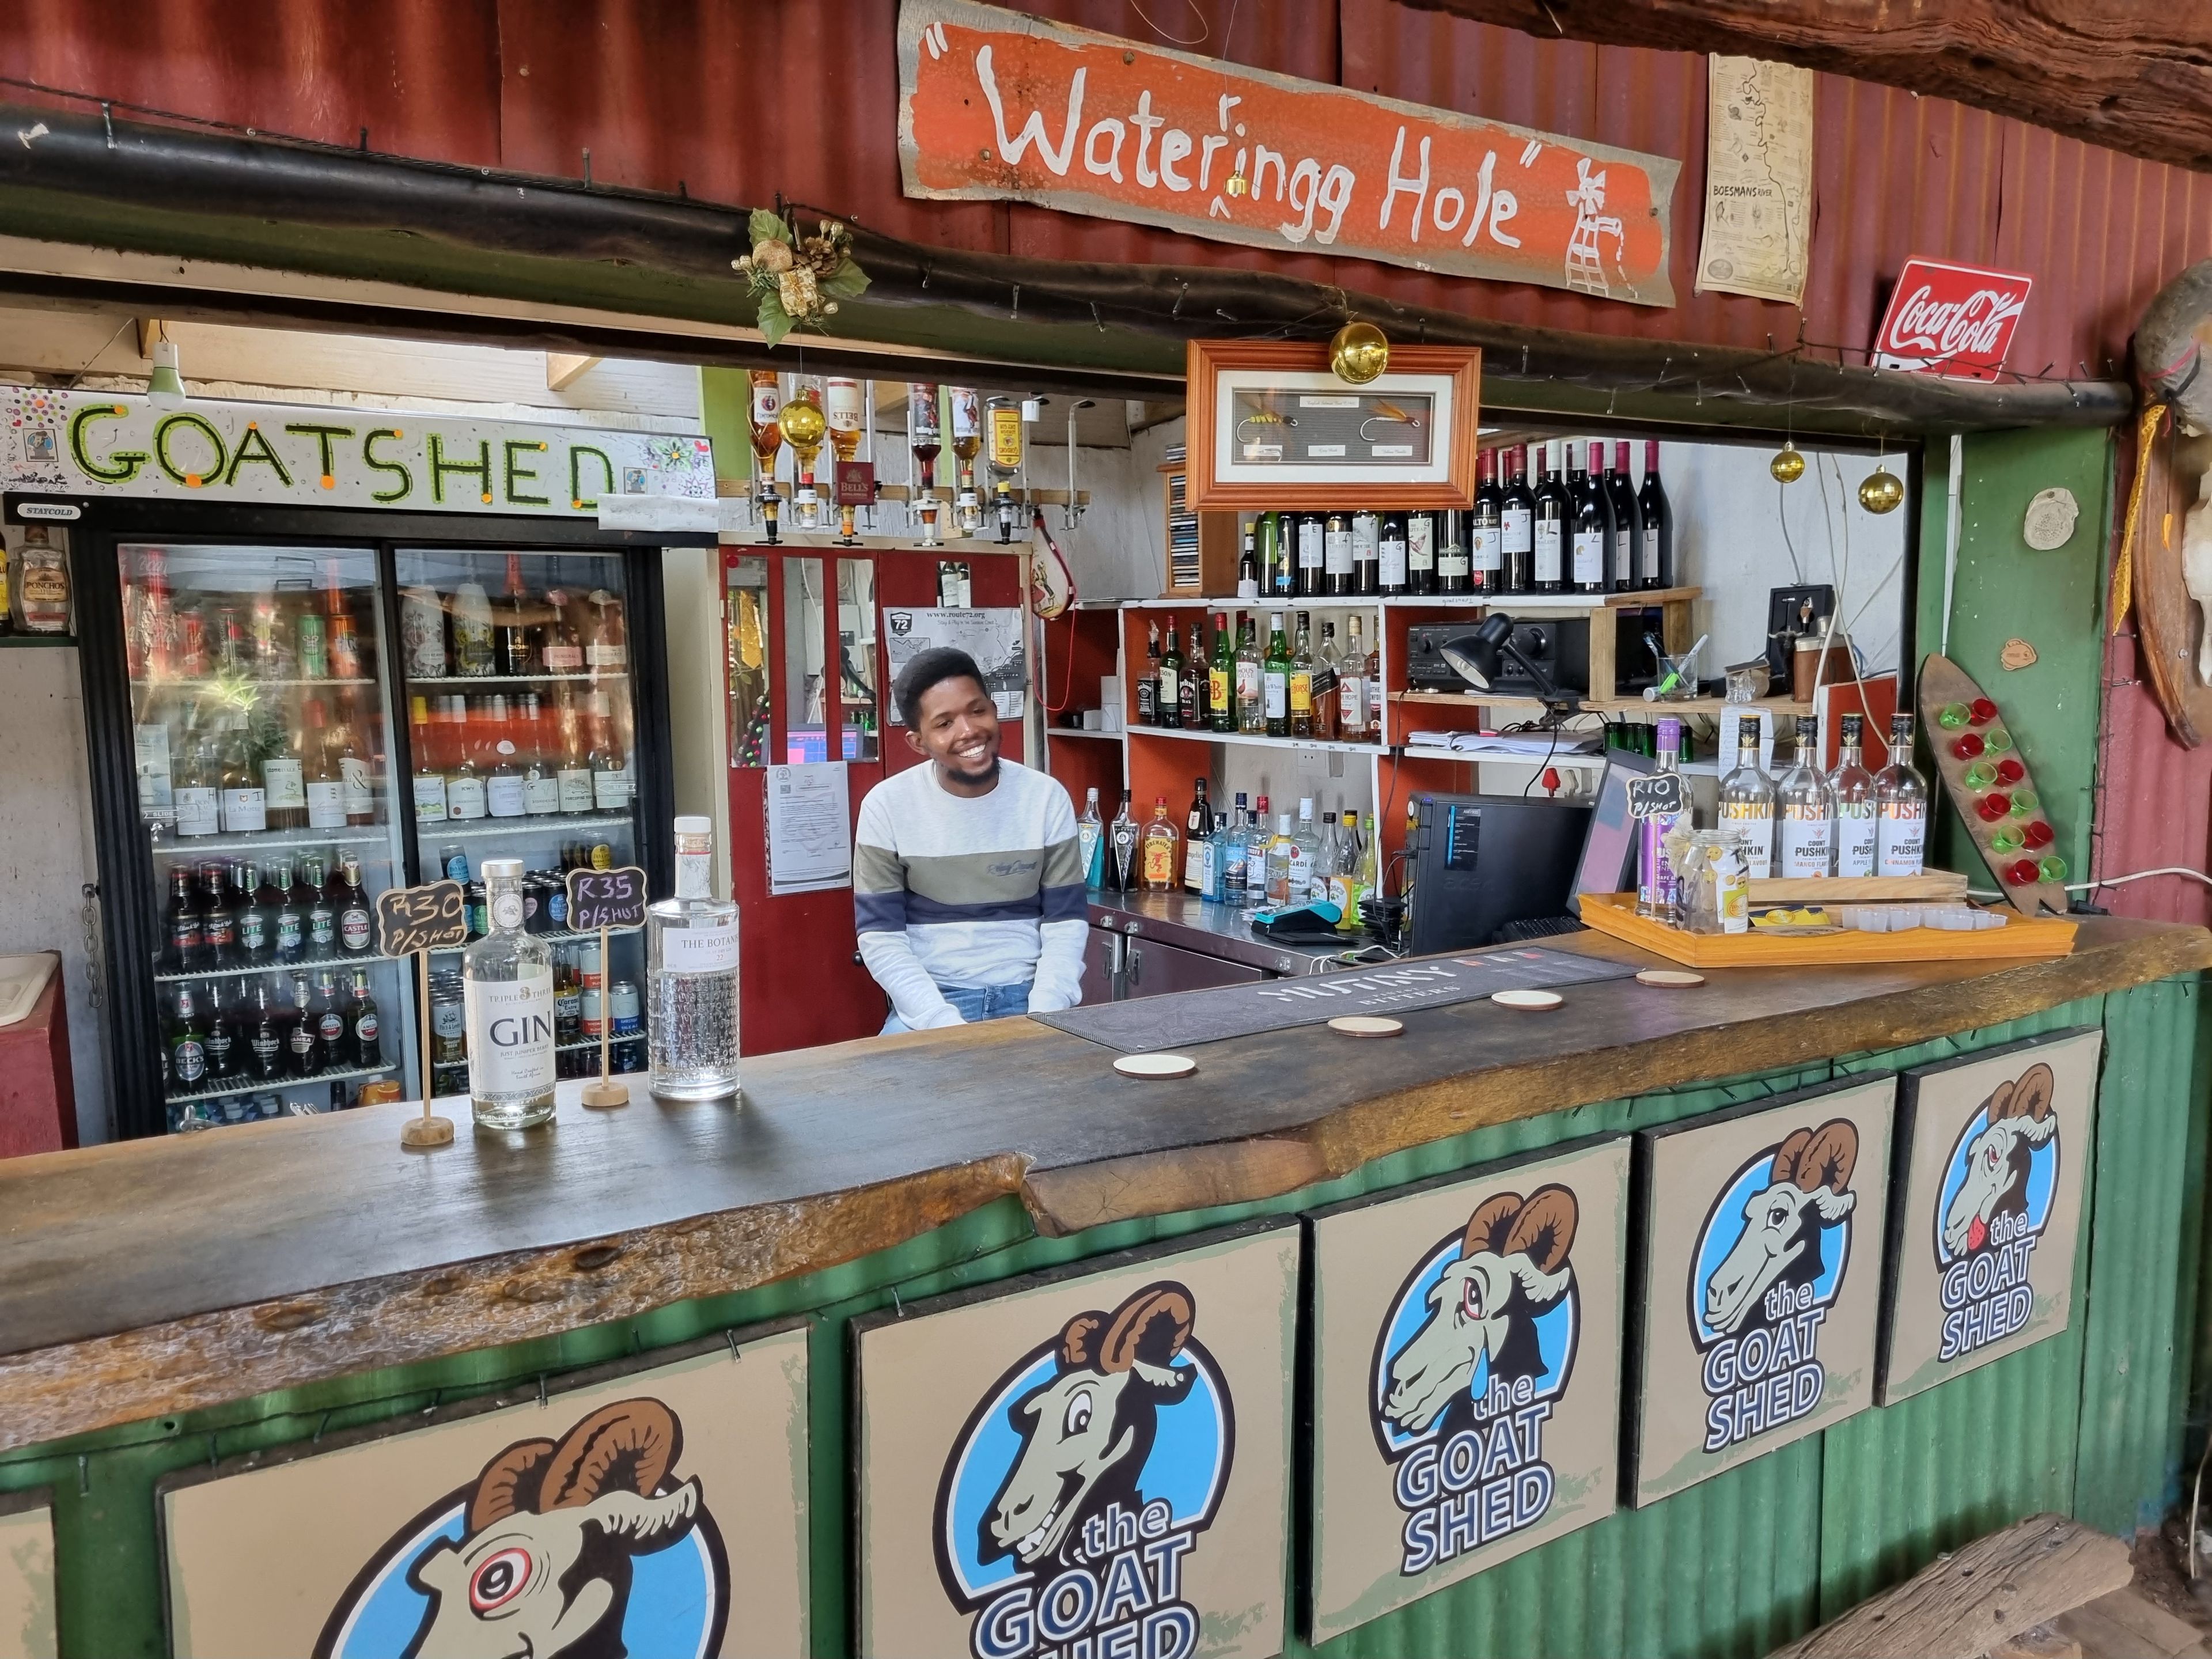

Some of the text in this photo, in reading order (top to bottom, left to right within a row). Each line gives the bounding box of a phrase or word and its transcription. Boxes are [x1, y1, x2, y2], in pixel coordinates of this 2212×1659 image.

[1714, 185, 1772, 198] BOESMANS RIVER
[841, 482, 869, 491] BELL'S
[26, 507, 73, 516] STAYCOLD
[894, 620, 908, 630] 72
[1634, 801, 1677, 816] P/SHOT
[1718, 801, 1774, 820] PUSHKIN
[1742, 845, 1764, 855] HKIN
[1290, 859, 1308, 868] CARDÍ
[389, 892, 461, 926] R30
[242, 925, 262, 935] LITE
[280, 923, 300, 934] LITE
[312, 919, 332, 930] LITE
[681, 940, 704, 948] THE
[488, 995, 518, 1003] TRIPLE
[1358, 984, 1461, 1006] BITTERS
[489, 1009, 552, 1047] GIN
[251, 1038, 280, 1047] Windhoek
[514, 1048, 536, 1056] JUNIPER
[1990, 1210, 2029, 1248] the
[1941, 1235, 2037, 1309] GOAT
[1764, 1280, 1814, 1323] the
[1940, 1284, 2033, 1362] SHED
[1704, 1308, 1826, 1395] GOAT
[1472, 1374, 1534, 1422] the
[1705, 1362, 1824, 1453] SHED
[1397, 1399, 1553, 1509] GOAT
[1082, 1498, 1173, 1559] the
[1403, 1466, 1554, 1574] SHED
[975, 1530, 1192, 1659] GOAT
